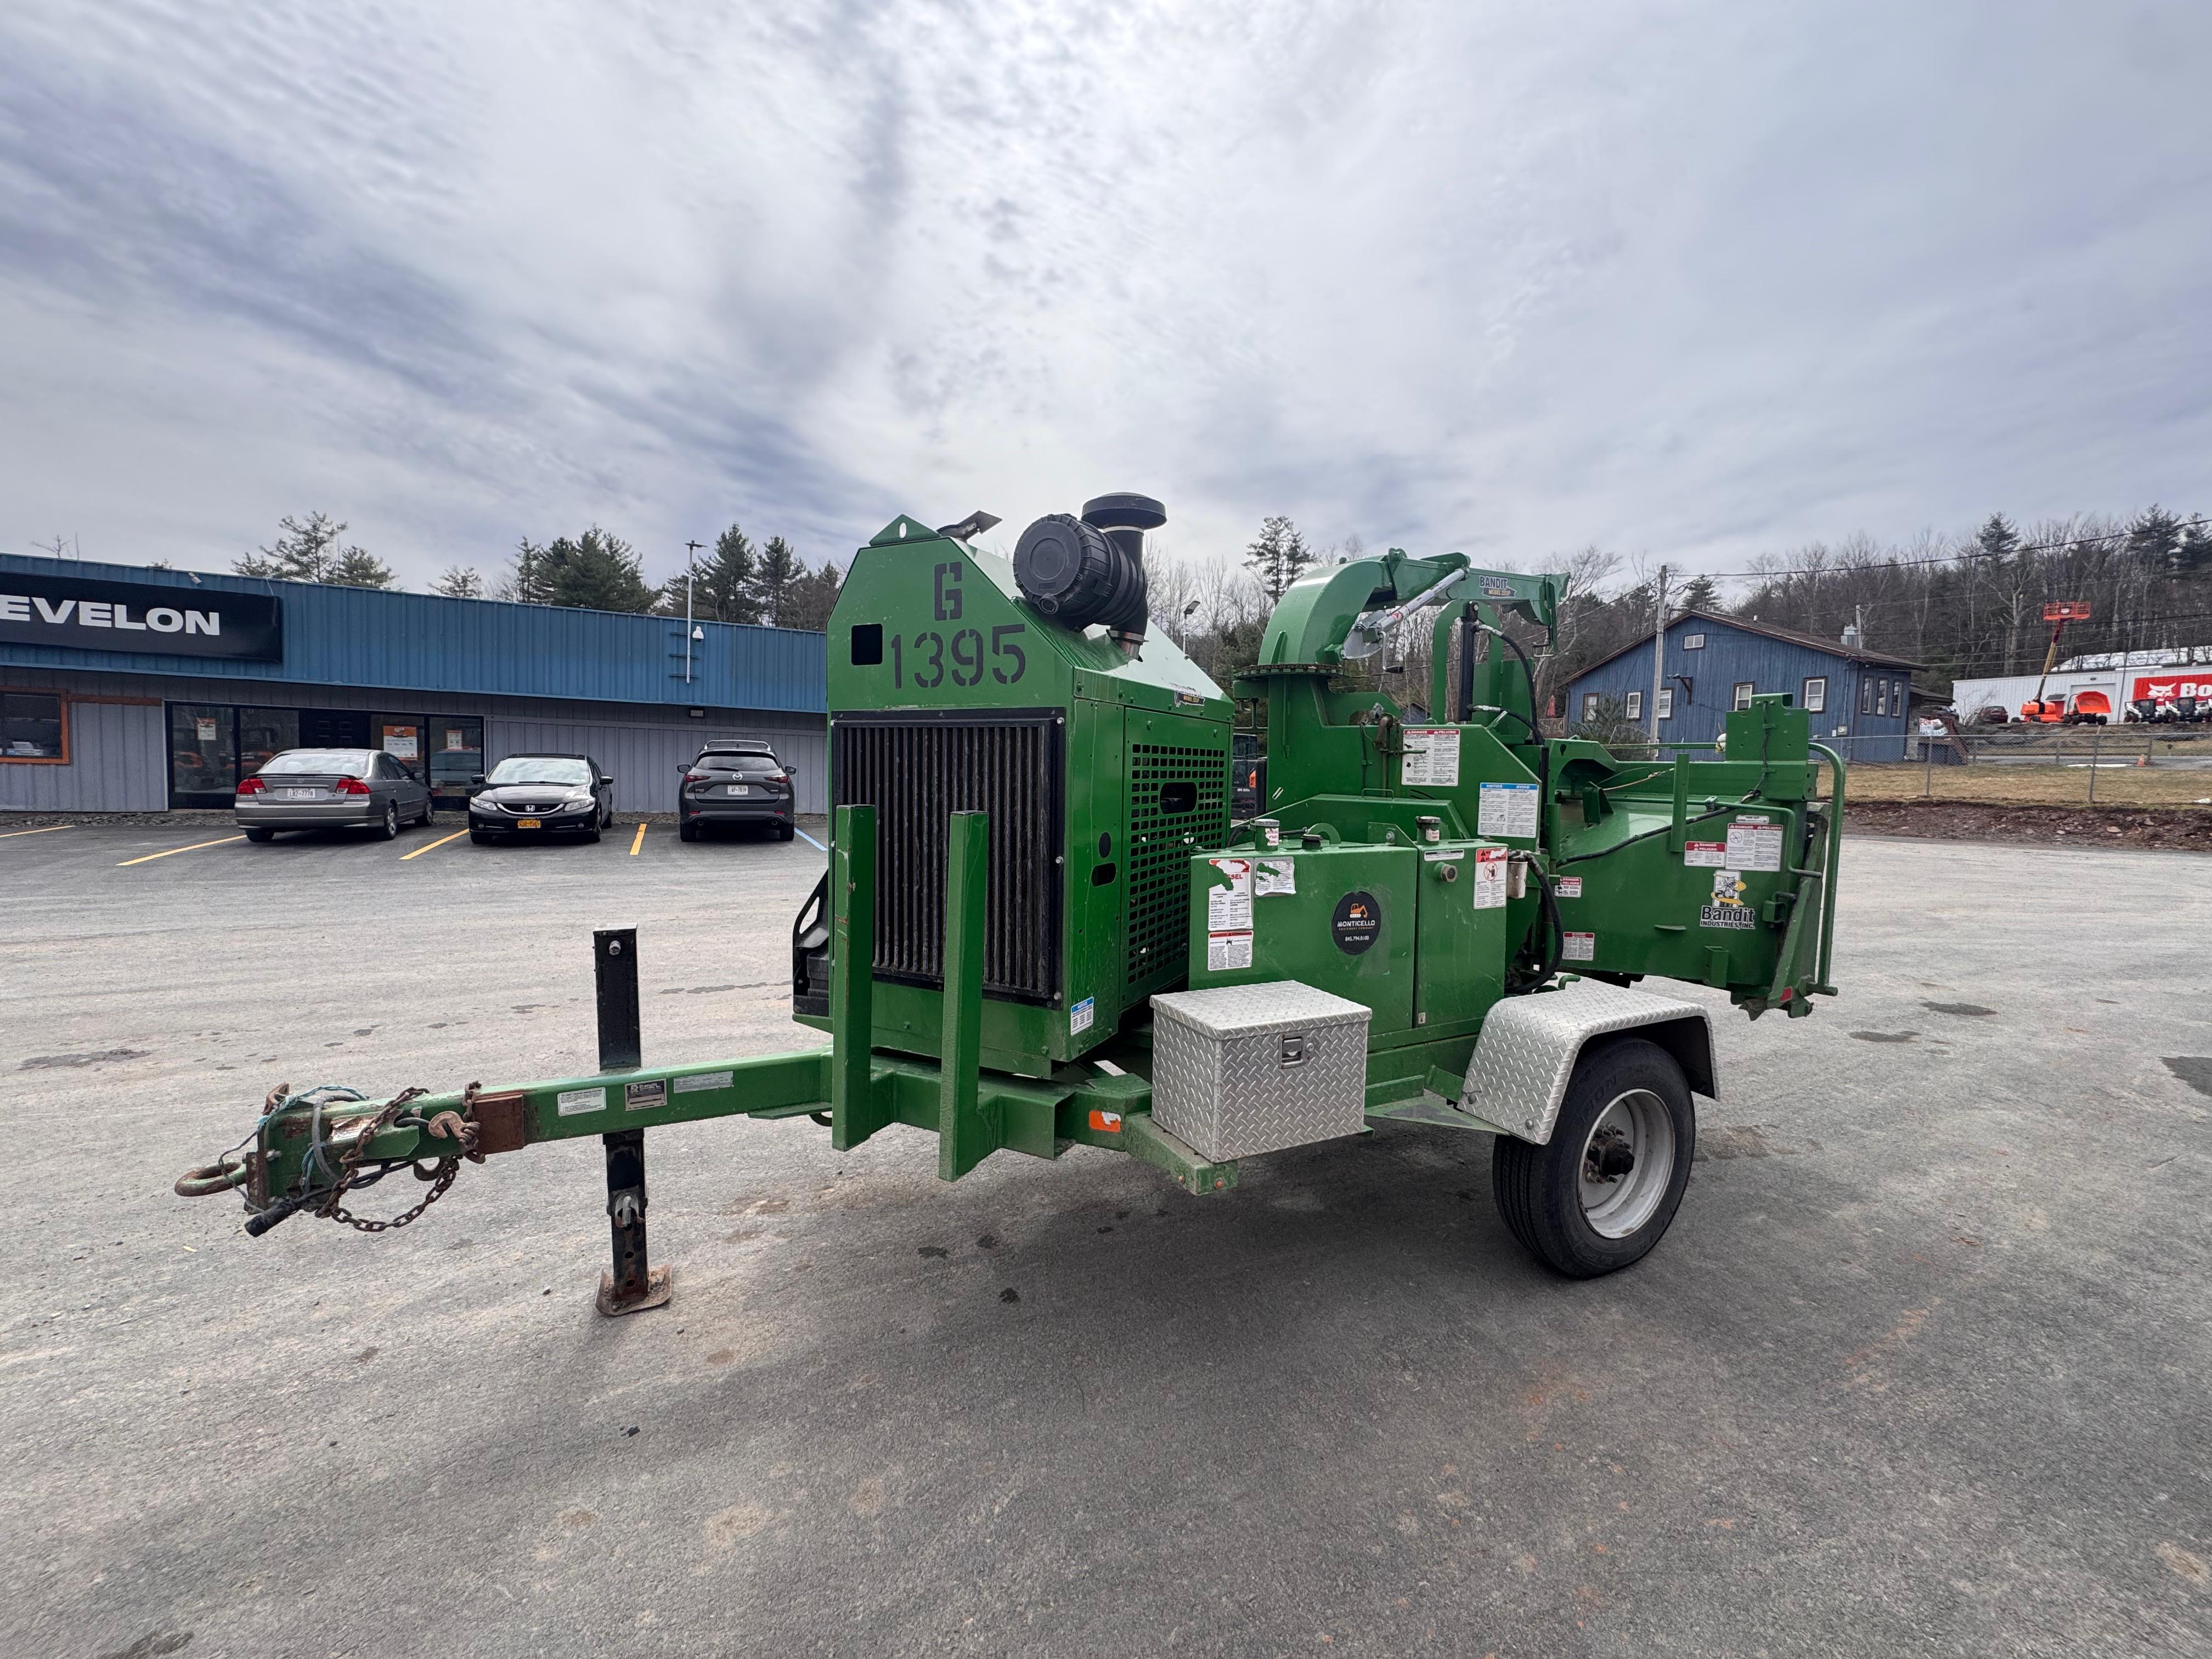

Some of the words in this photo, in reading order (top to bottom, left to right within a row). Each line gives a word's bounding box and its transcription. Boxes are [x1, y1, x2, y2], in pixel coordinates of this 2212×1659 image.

[934, 561, 962, 621] G
[1480, 576, 1508, 590] BANDIT
[0, 594, 220, 635] EVELON
[891, 624, 1026, 689] 1395
[1701, 906, 1754, 922] Bandit
